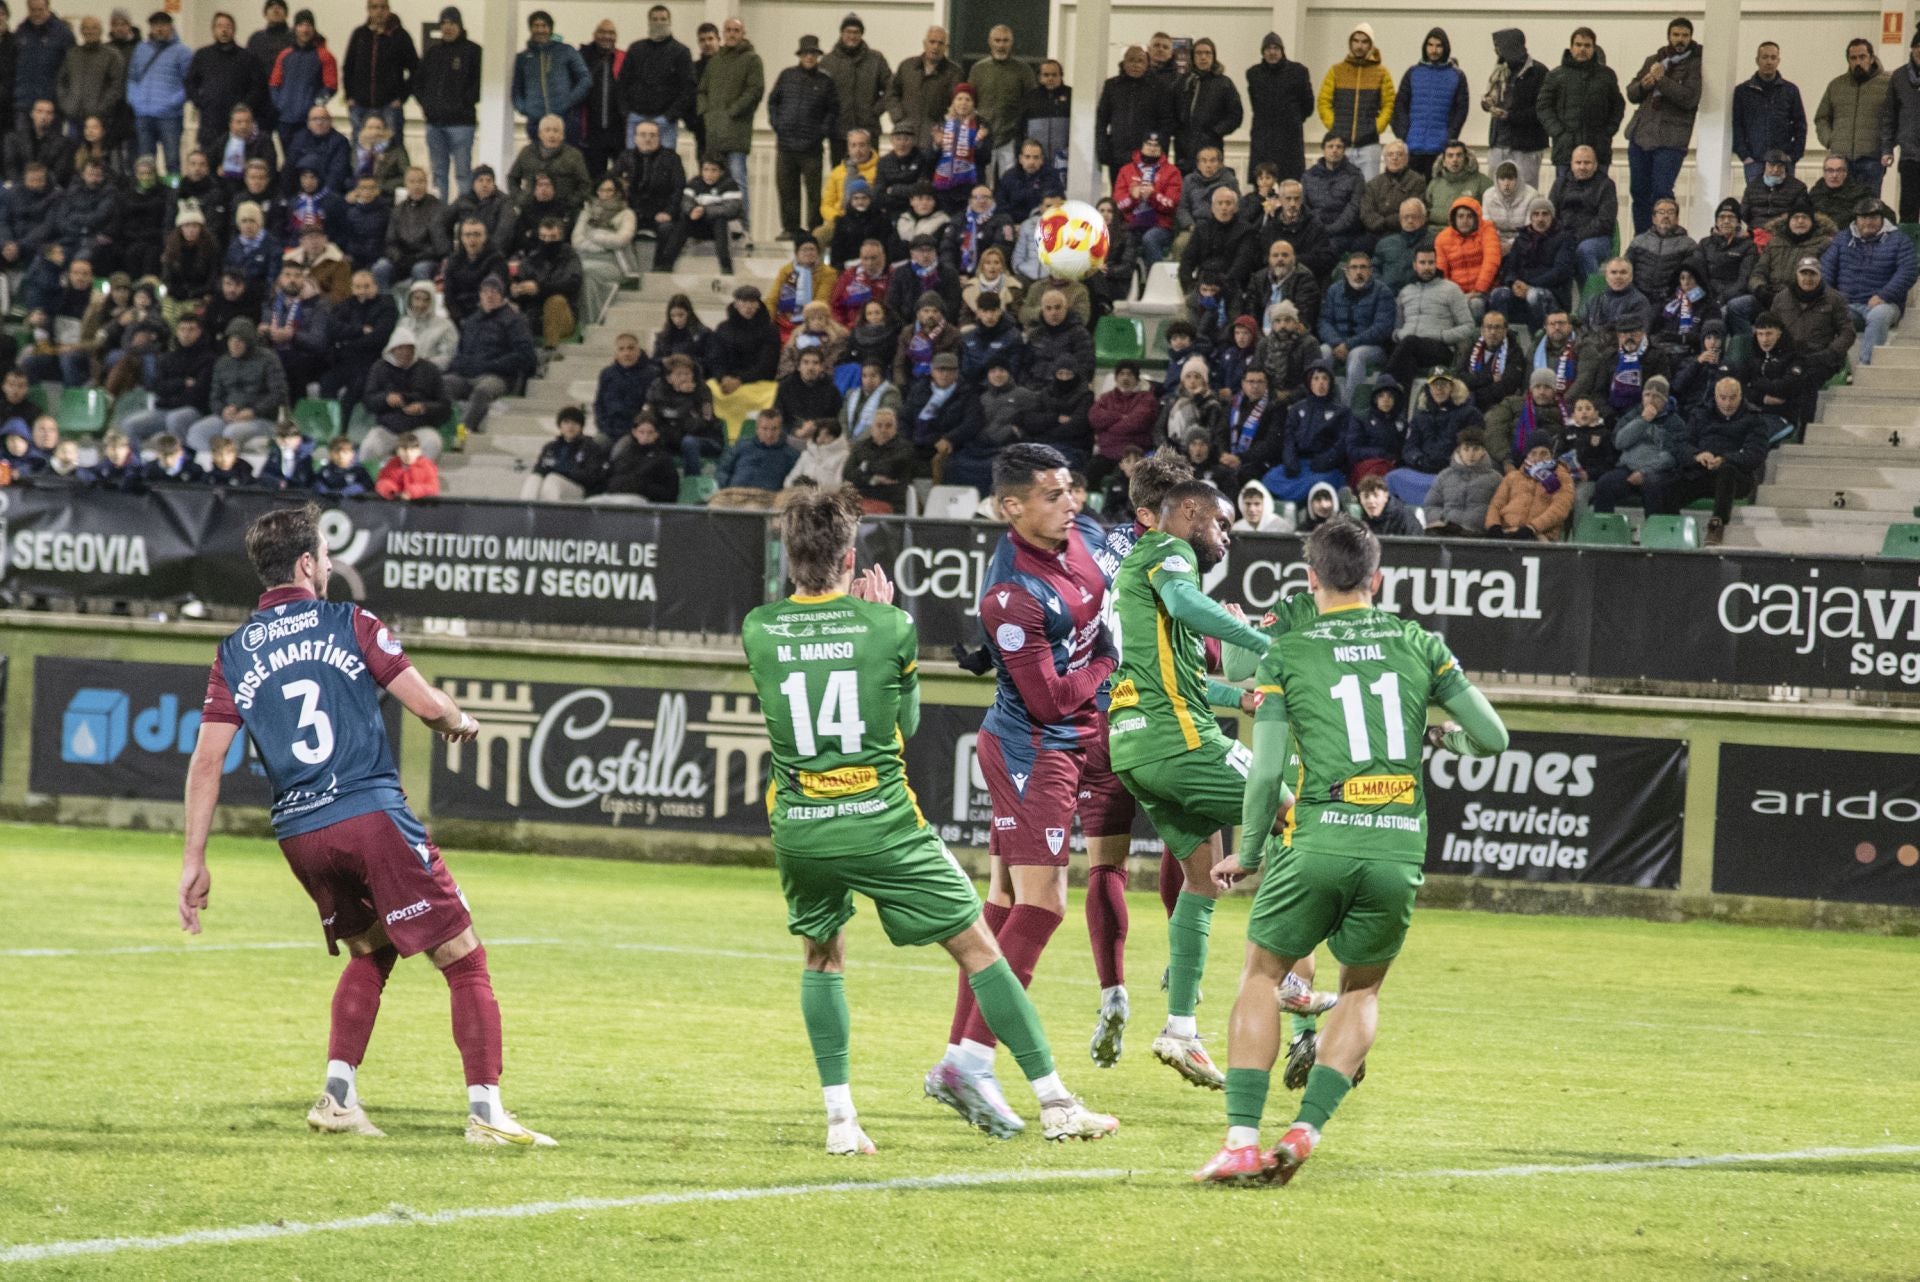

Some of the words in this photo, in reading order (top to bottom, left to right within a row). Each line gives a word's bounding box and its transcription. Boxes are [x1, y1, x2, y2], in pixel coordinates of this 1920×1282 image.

[1888, 430, 1900, 447] 4
[1834, 491, 1846, 508] 3
[12, 529, 150, 576] SEGOVIA
[386, 531, 500, 560] INSTITUTO
[505, 536, 623, 567] MUNICIPAL
[629, 542, 658, 568] DE
[383, 560, 520, 595] DEPORTES
[541, 568, 658, 601] SEGOVIA
[894, 533, 986, 616] caj
[268, 609, 318, 630] OCTAVIANO
[268, 617, 319, 642] PALOMO
[776, 610, 855, 622] RESTAURANTE
[1315, 616, 1389, 628] RESTAURANTE
[777, 645, 797, 662] M.
[800, 642, 854, 661] MANSO
[1333, 644, 1386, 662] NISTAL
[235, 653, 271, 709] JOSÉ
[269, 634, 366, 680] MARTÍNEZ
[281, 679, 334, 764] 3
[780, 670, 866, 756] 14
[1330, 672, 1406, 762] 11
[528, 688, 709, 809] Castilla
[1349, 782, 1361, 796] EL
[1751, 789, 1920, 822] arido
[787, 805, 835, 820] ATLETICO
[837, 799, 889, 817] ASTORGA
[1375, 815, 1421, 832] ASTORGA
[1461, 802, 1590, 837] Servicios
[1442, 833, 1589, 871] Integrales
